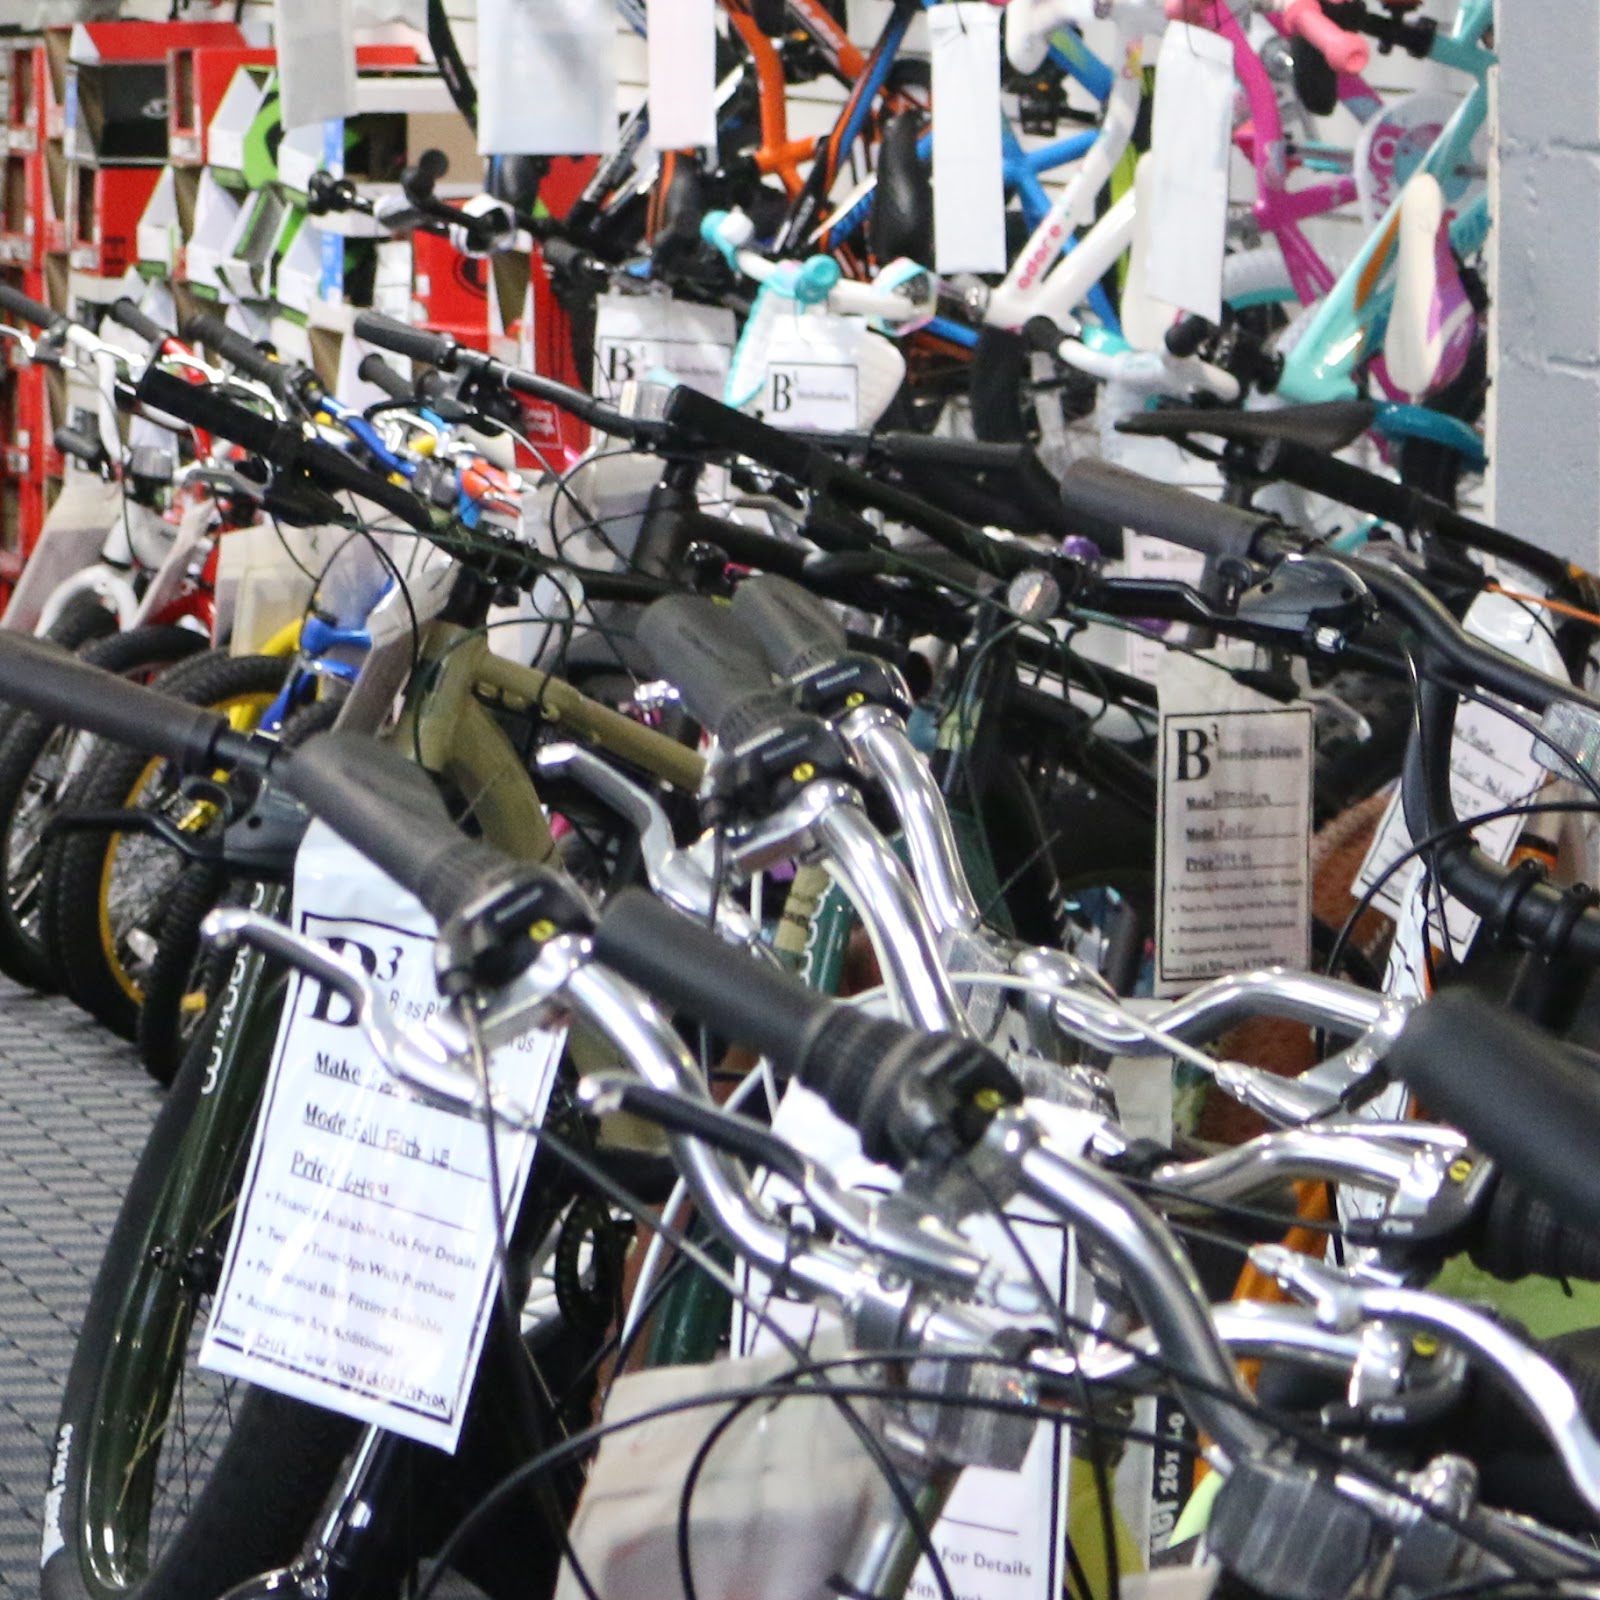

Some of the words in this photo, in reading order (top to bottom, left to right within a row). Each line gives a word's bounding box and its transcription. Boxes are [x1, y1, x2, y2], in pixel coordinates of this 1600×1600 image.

[315, 1050, 362, 1085] Make
[939, 1545, 969, 1564] For
[973, 1550, 1033, 1578] Details
